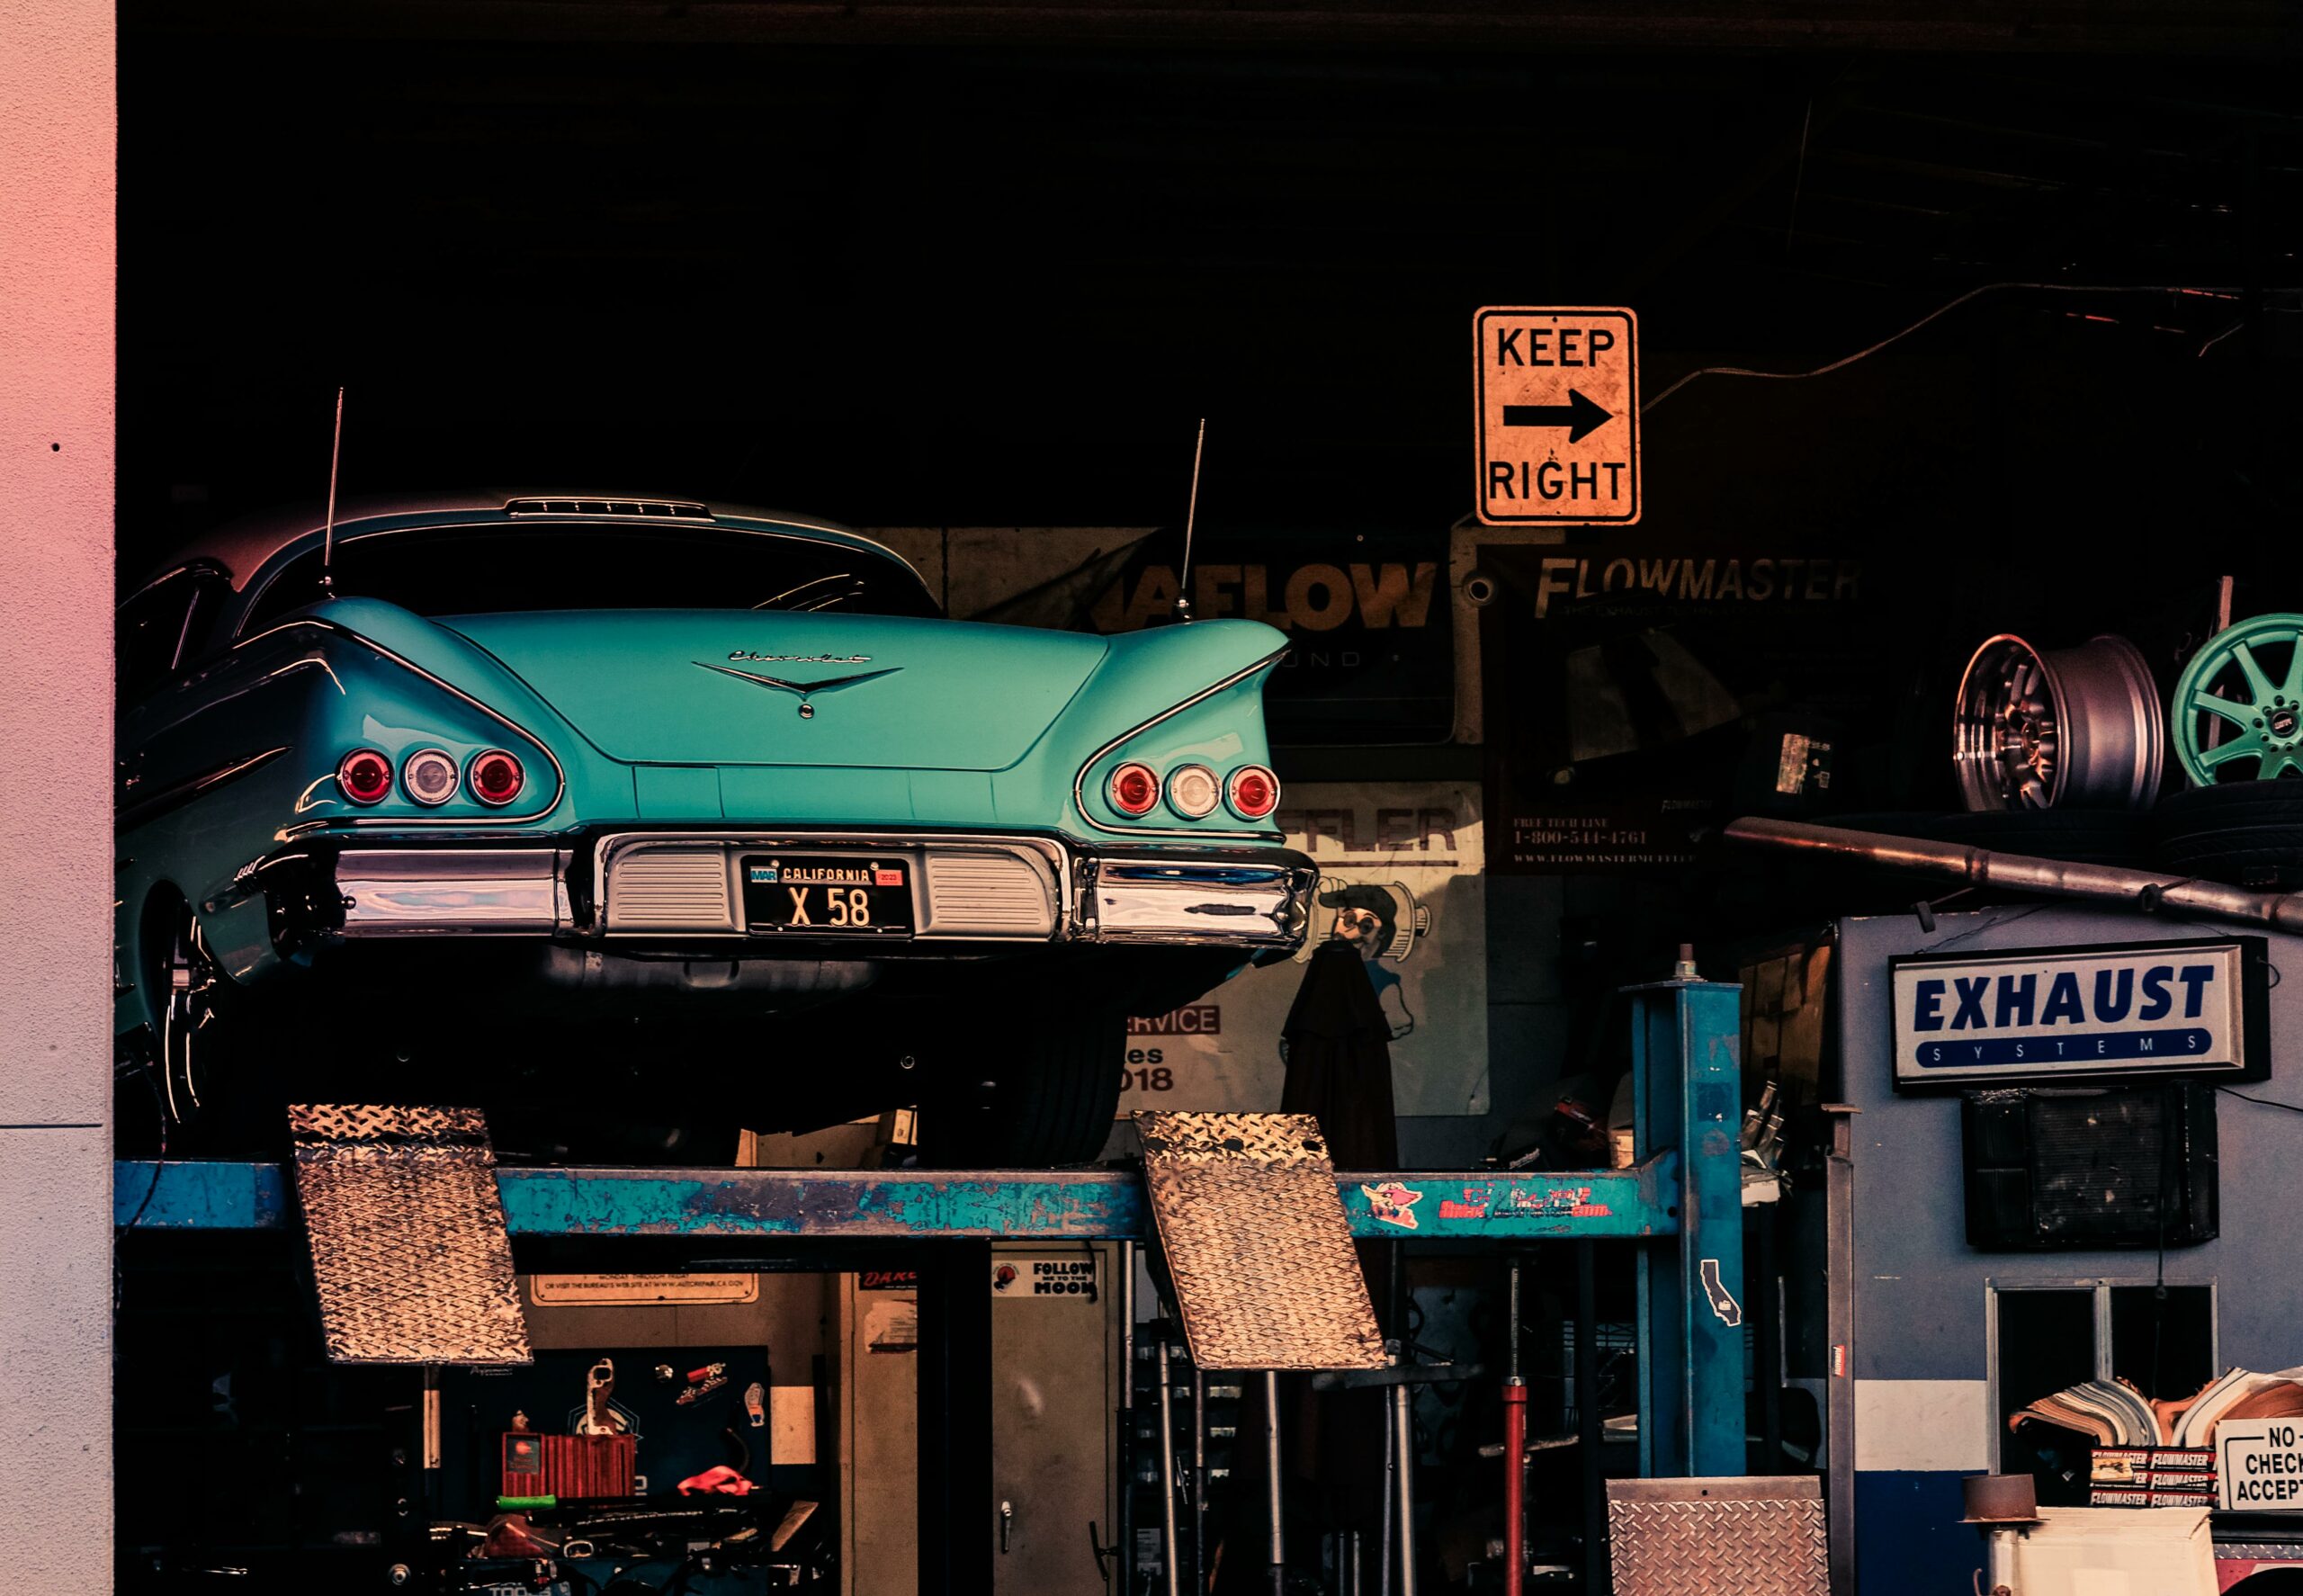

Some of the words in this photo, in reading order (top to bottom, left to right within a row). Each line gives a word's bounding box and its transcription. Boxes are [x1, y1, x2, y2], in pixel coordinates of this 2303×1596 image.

[1498, 328, 1615, 367] KEEP
[1490, 462, 1626, 500] RIGHT
[1534, 557, 1863, 619] FLOWMASTER
[1281, 650, 1360, 668] UND
[1513, 817, 1544, 828] FREE
[1547, 817, 1578, 828] TECH
[1582, 817, 1610, 828] LINE
[1513, 829, 1648, 845] 1-800-544-4761
[750, 870, 776, 881] MAR
[783, 867, 870, 882] CALIFORNIA
[788, 886, 811, 927] X
[827, 887, 870, 928] 58
[1913, 964, 2215, 1032] EXHAUST
[1126, 1009, 1217, 1033] RVICE
[1127, 1048, 1163, 1064] es
[1933, 1036, 2197, 1062] SYSTEMS
[1034, 1262, 1094, 1275] FOLLOW
[1034, 1282, 1095, 1294] MOON
[2269, 1427, 2295, 1448] NO
[2150, 1453, 2209, 1469] FLOWMASTER
[2091, 1493, 2147, 1505] FLOWMASTER
[2150, 1494, 2209, 1508] FLOWMASTER
